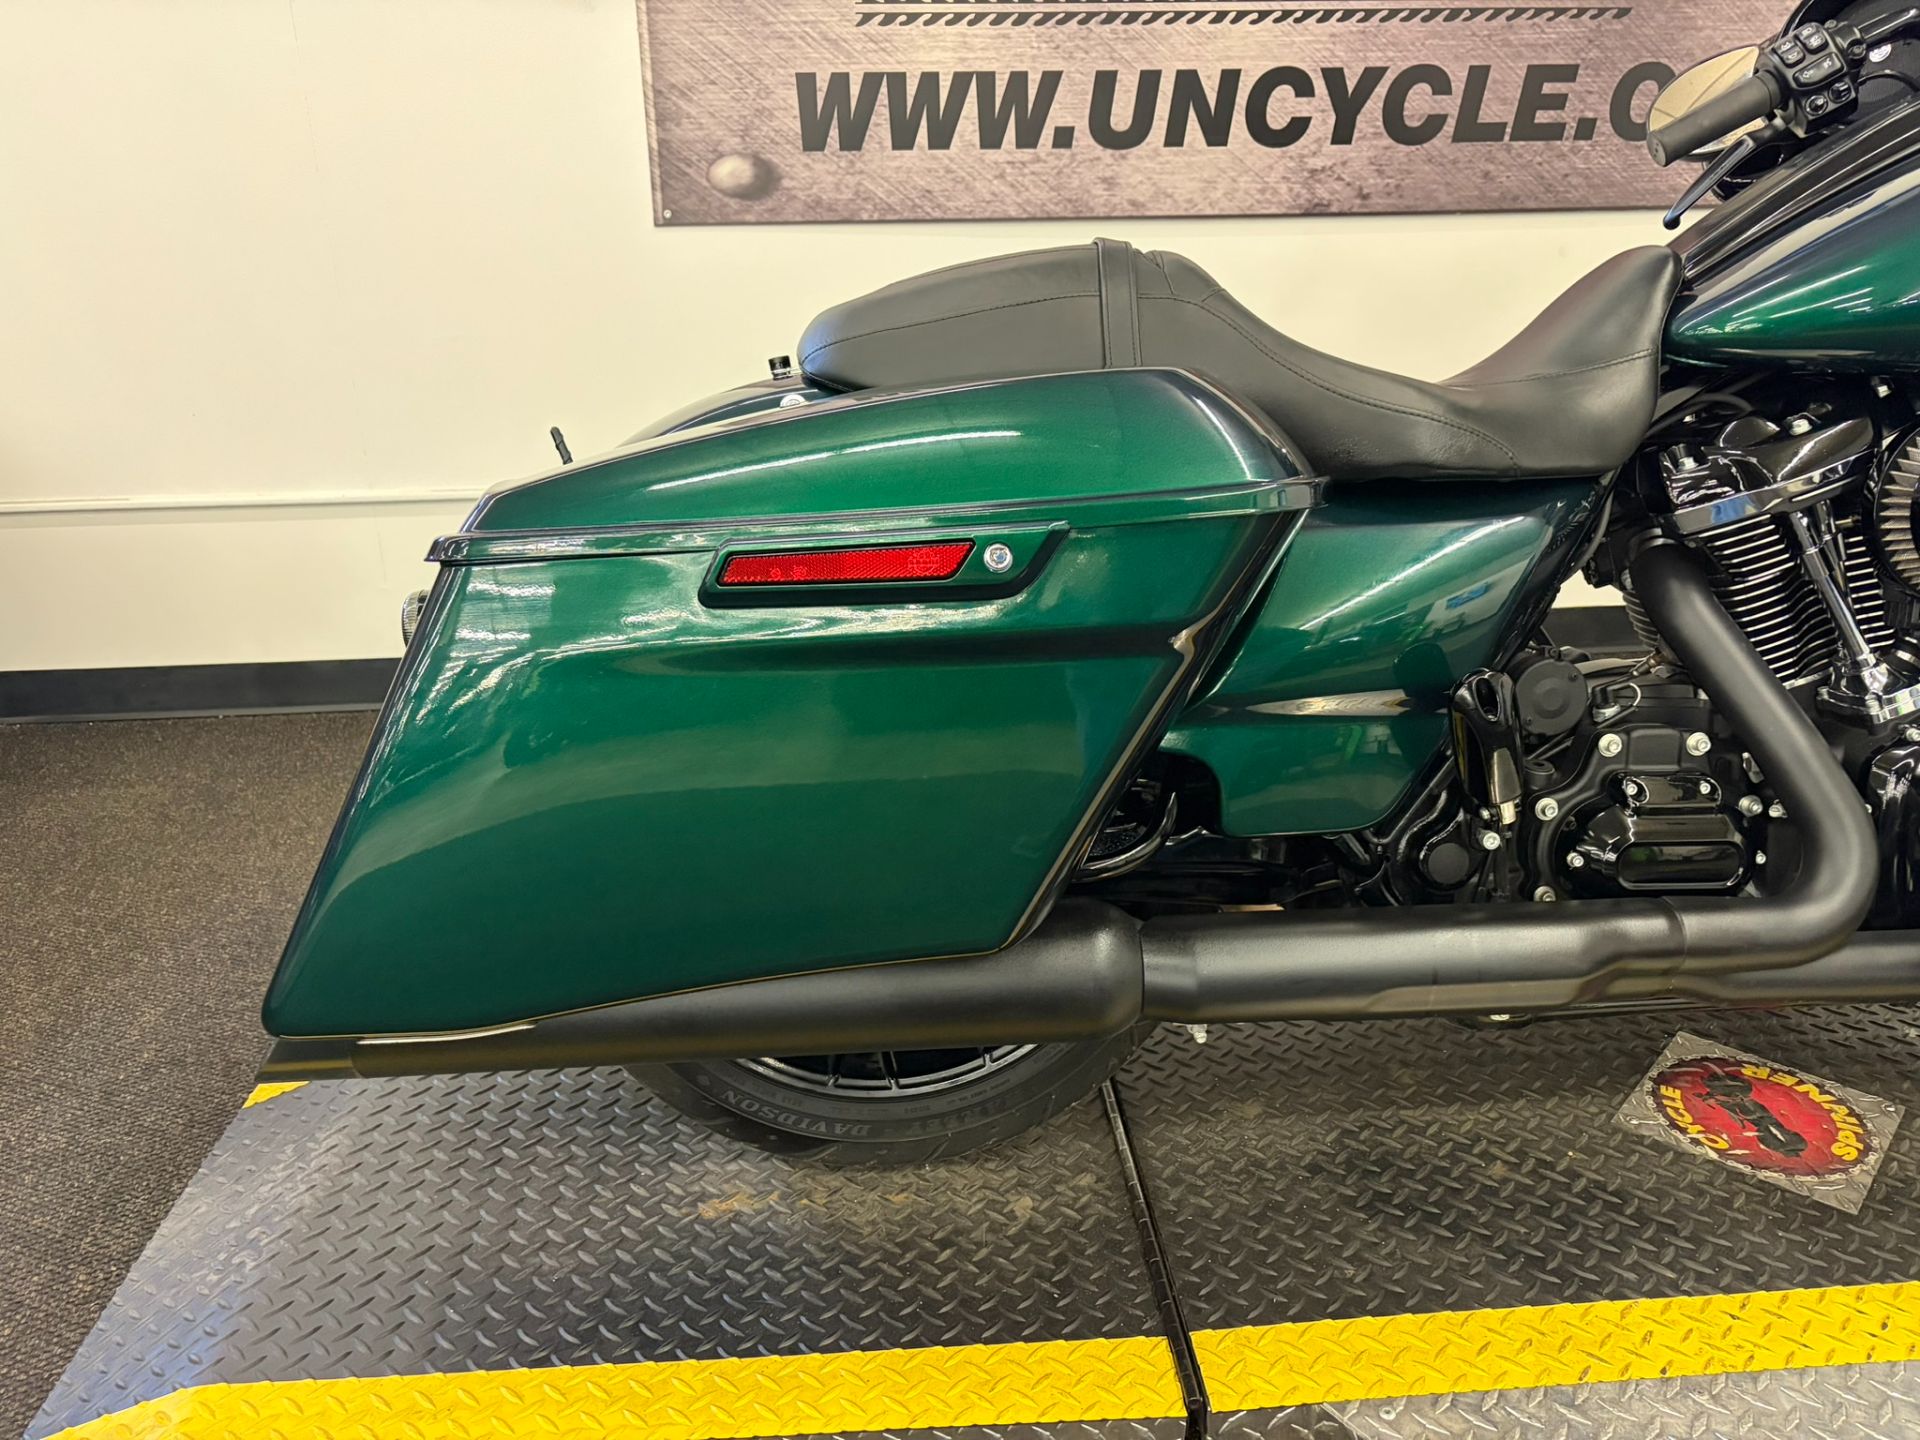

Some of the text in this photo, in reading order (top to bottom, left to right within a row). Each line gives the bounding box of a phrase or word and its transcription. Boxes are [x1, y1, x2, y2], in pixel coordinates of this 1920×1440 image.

[722, 1090, 872, 1136] DAVIDSON
[1660, 1063, 1864, 1161] CYCLE SPINNER
